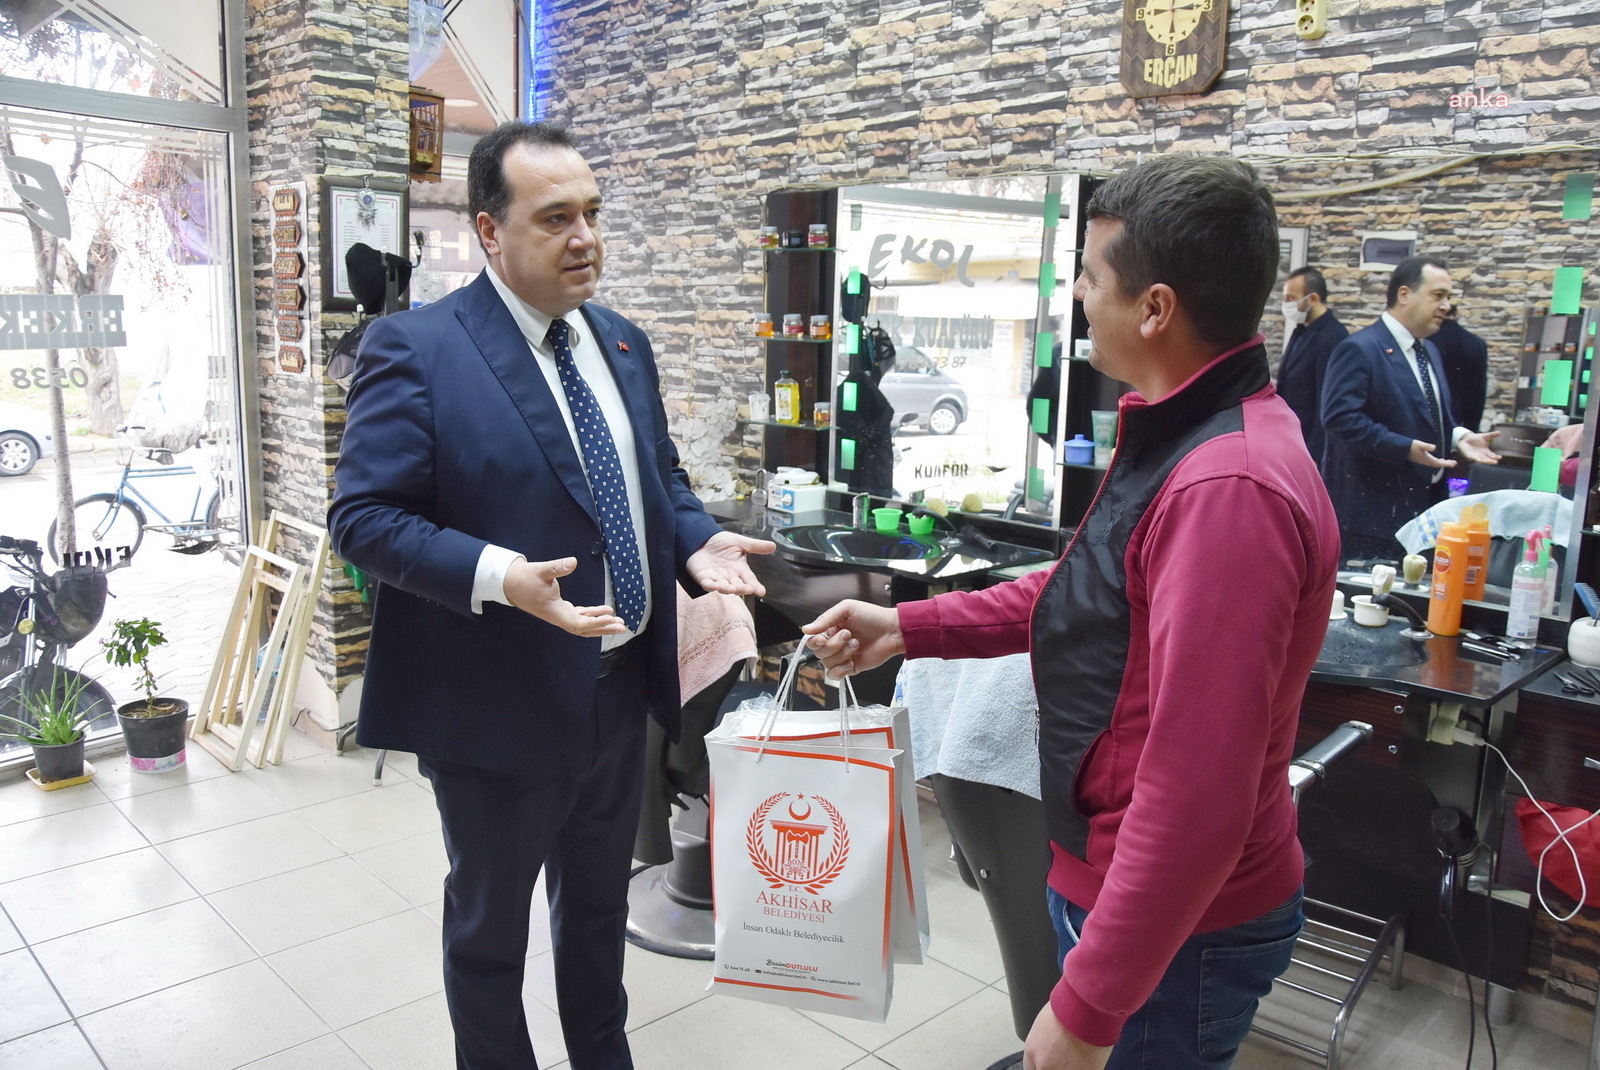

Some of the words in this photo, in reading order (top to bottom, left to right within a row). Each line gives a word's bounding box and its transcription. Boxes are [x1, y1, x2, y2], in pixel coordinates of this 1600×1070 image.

[1137, 9, 1145, 19] 9
[1167, 44, 1174, 55] 6
[1144, 54, 1198, 88] ERCAN
[867, 234, 975, 288] EKOL
[951, 356, 967, 369] 87
[788, 885, 803, 894] T.C.
[756, 890, 833, 914] AKHİSAR
[763, 906, 825, 923] BELEDİYESİ
[743, 920, 763, 932] İnsan
[765, 925, 791, 937] Odaklı
[793, 929, 845, 943] Belediyecilik
